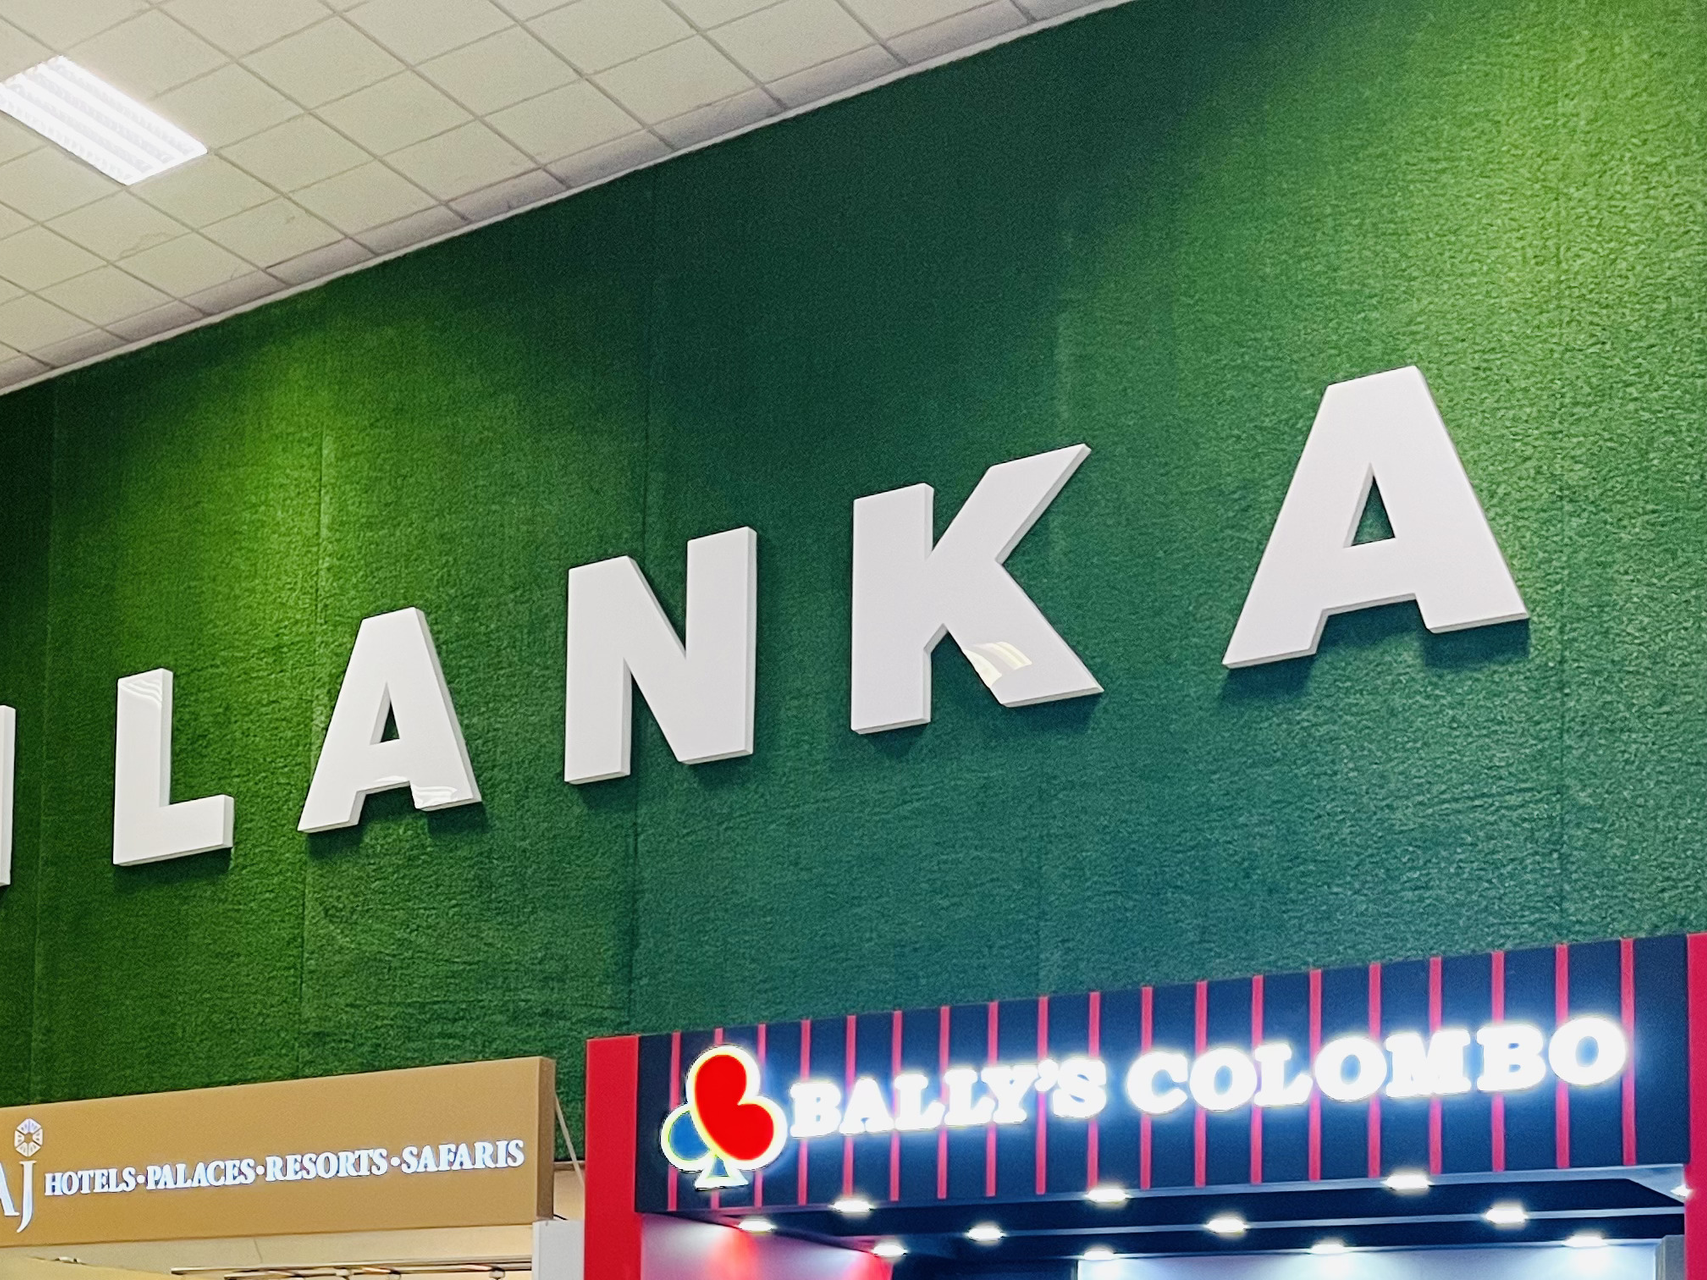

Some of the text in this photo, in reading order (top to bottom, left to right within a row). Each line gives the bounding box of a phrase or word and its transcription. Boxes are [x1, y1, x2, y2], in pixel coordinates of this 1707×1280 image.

[113, 366, 1530, 866] LANKA
[788, 1016, 1628, 1138] BALLY'S COLOMBO
[45, 1163, 137, 1196] HOTELS
[145, 1157, 256, 1191] PALACES
[264, 1148, 388, 1185] RESORTS
[401, 1138, 525, 1174] SAFARIS
